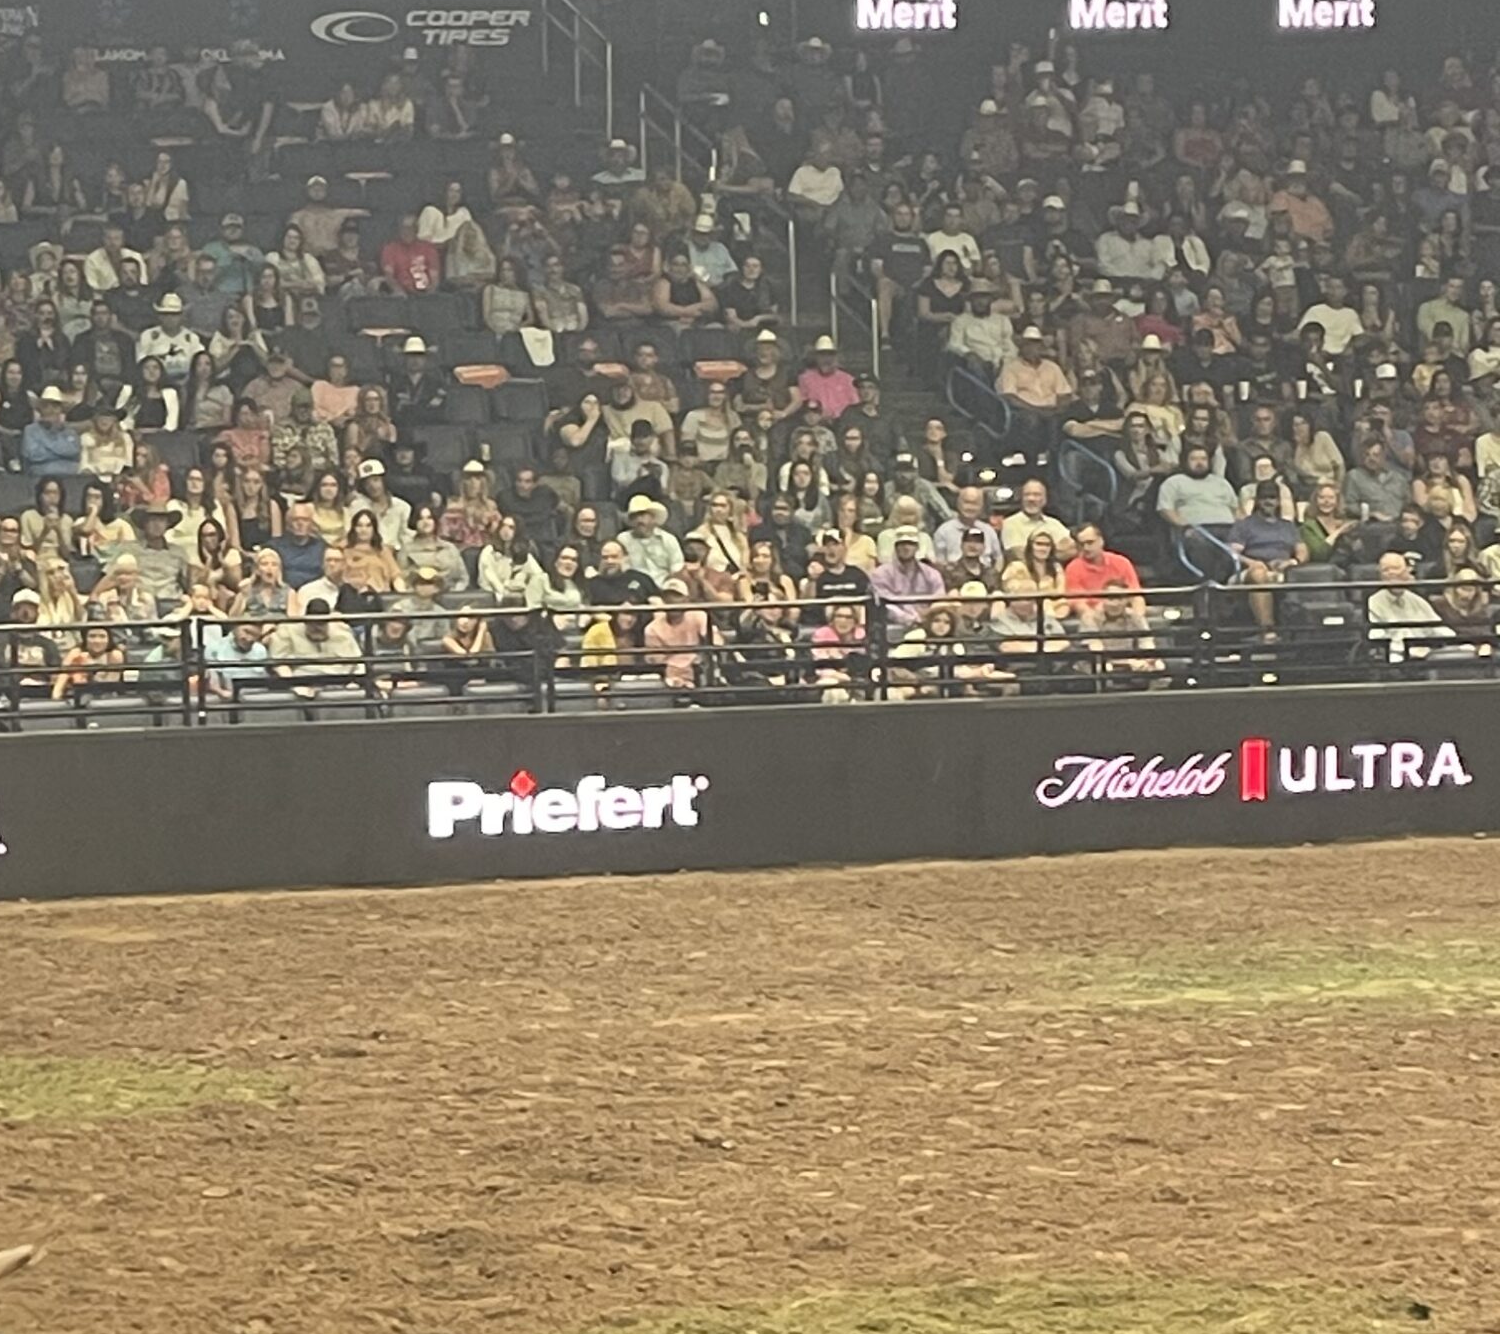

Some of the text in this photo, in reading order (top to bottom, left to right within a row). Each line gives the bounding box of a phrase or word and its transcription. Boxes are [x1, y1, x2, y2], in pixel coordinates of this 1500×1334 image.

[405, 10, 531, 27] COOPER
[422, 29, 510, 46] TIRES
[1036, 742, 1472, 807] Michelob ULTRA
[428, 770, 699, 838] Priefert
